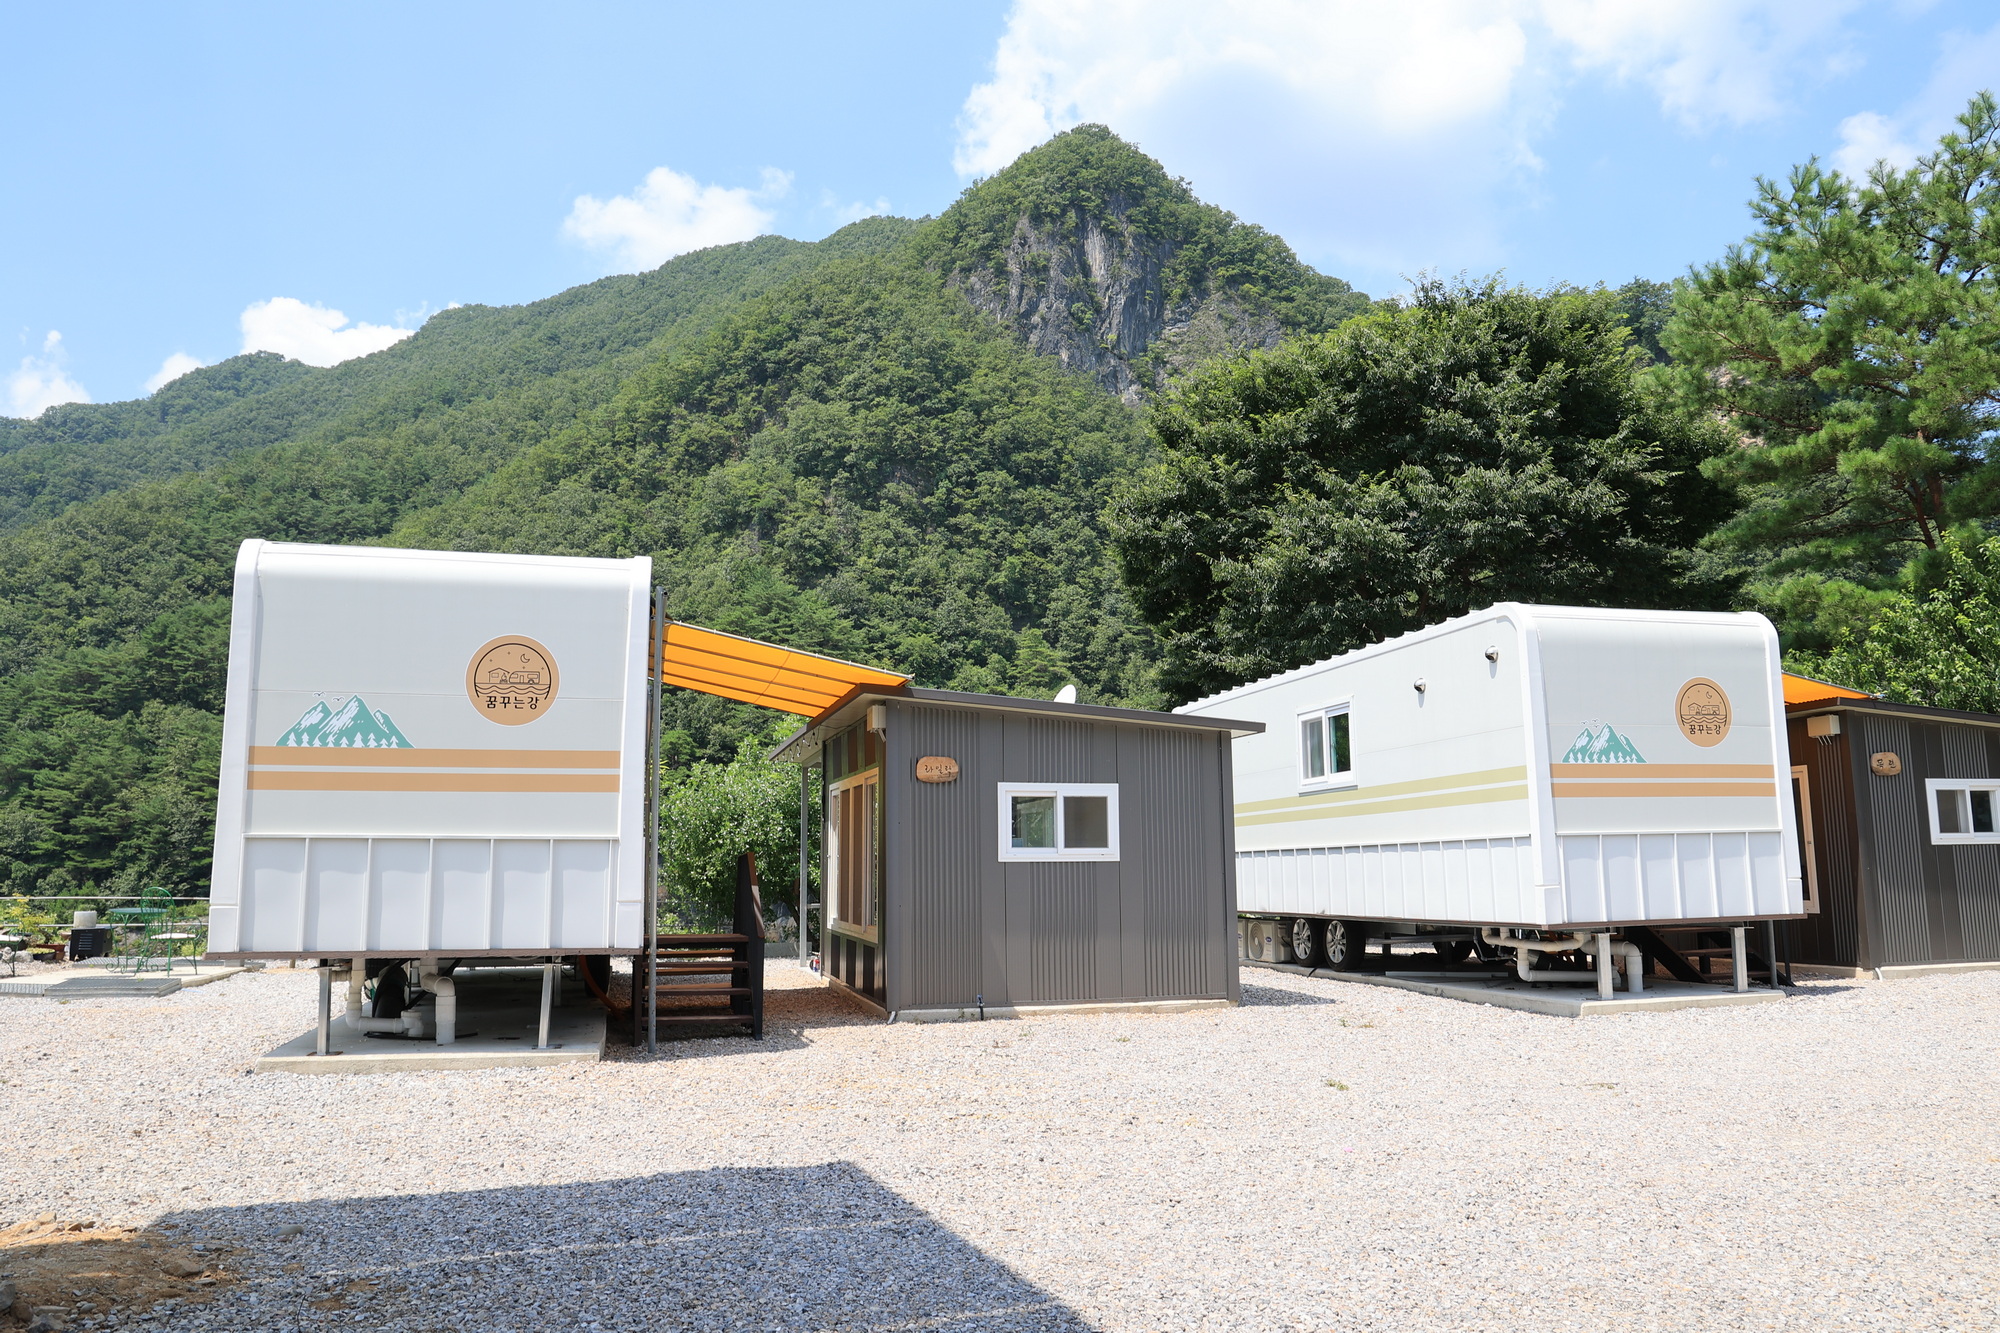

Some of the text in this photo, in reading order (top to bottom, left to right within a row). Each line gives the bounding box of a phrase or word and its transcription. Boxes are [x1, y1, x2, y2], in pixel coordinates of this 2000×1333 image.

[486, 696, 540, 710] 꿈꾸는강
[1689, 724, 1722, 735] 꿈꾸는강
[924, 763, 952, 777] 라일락
